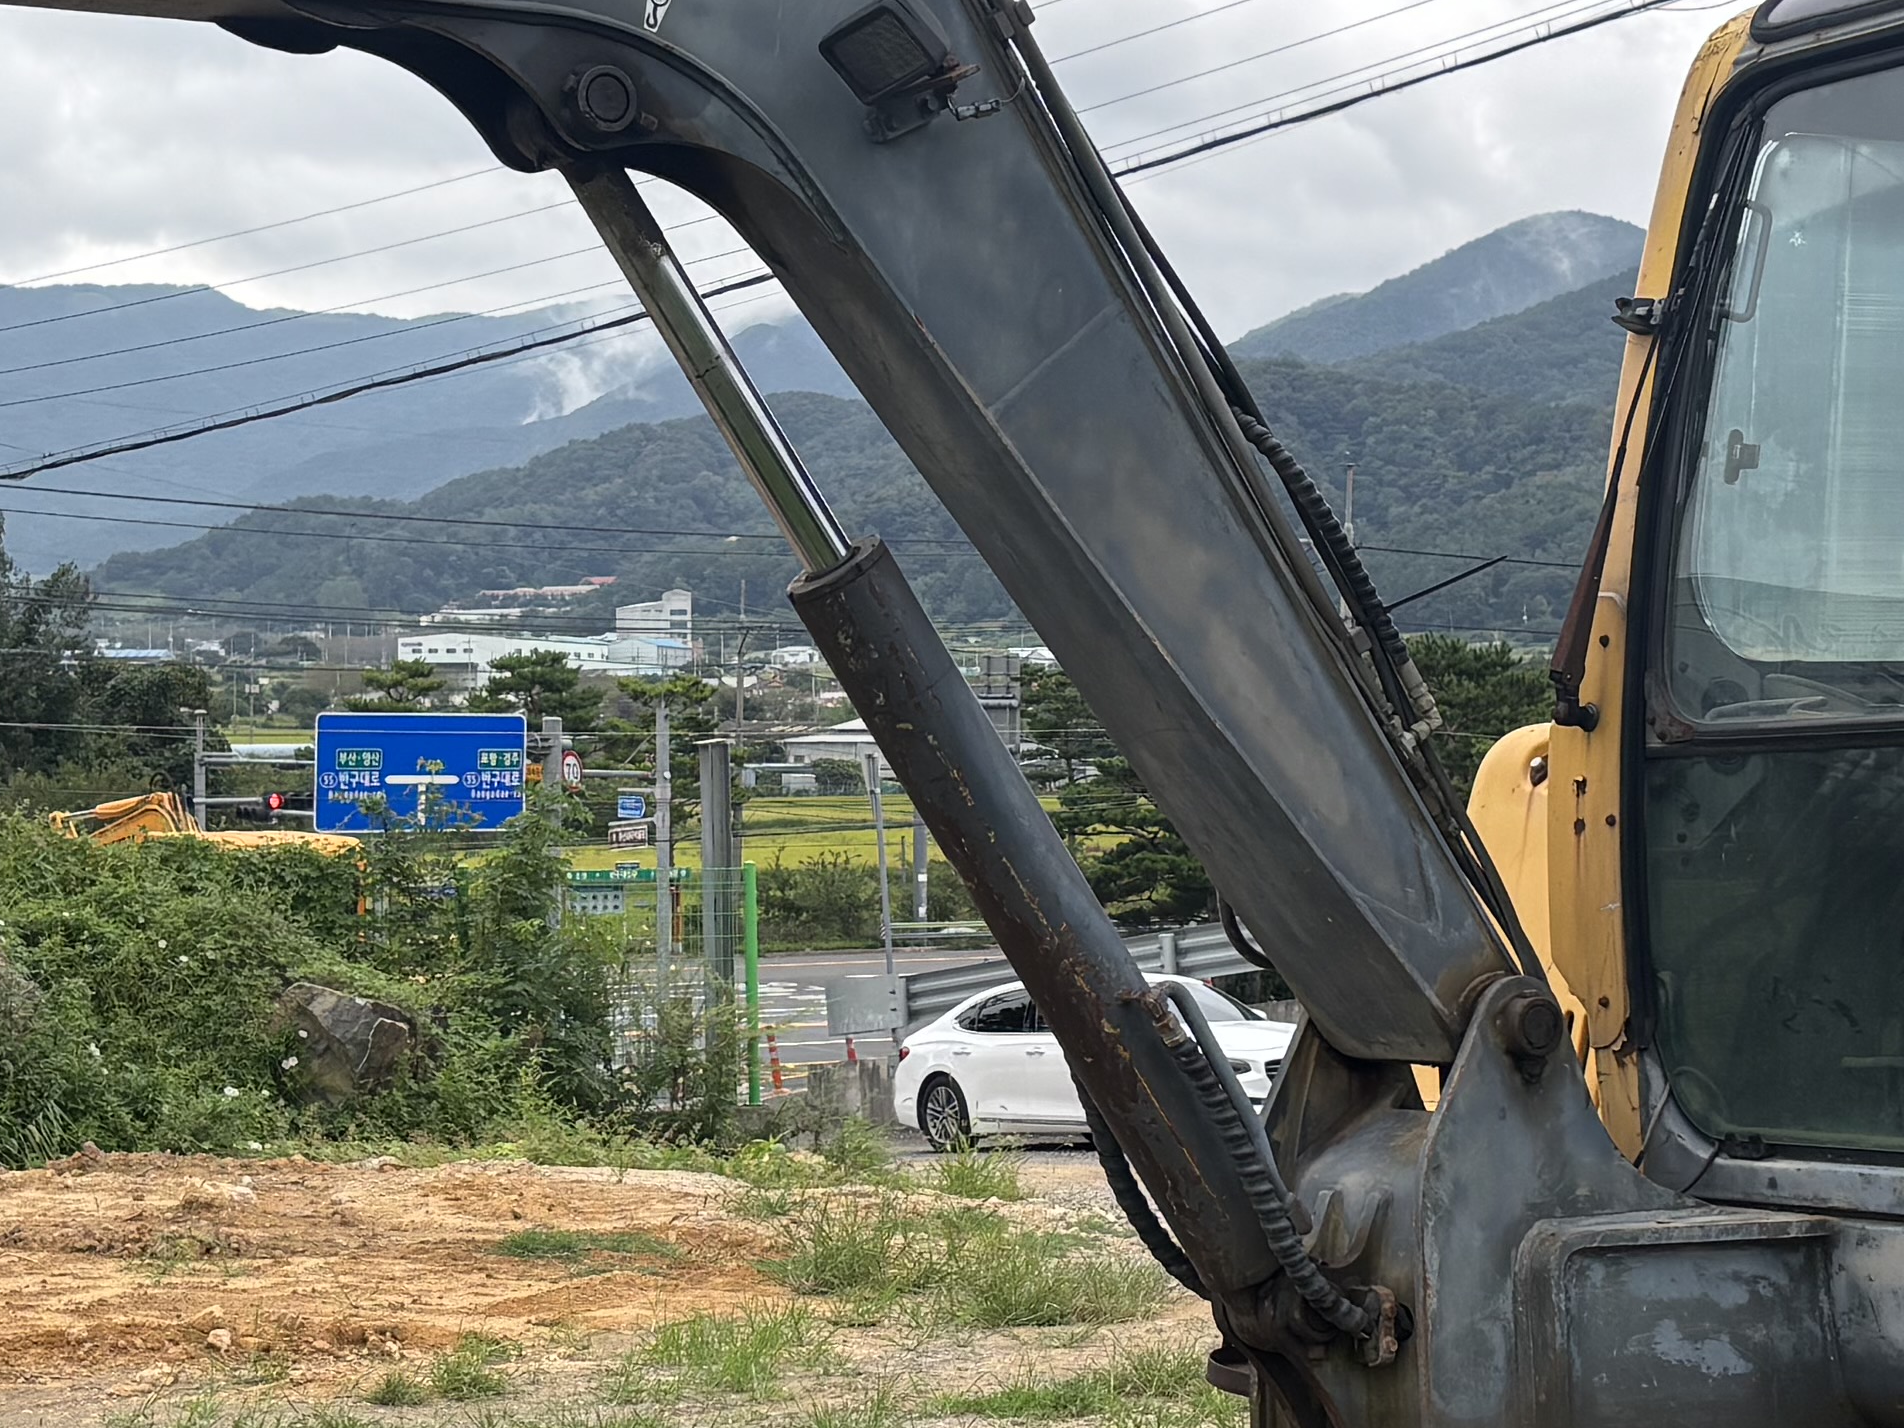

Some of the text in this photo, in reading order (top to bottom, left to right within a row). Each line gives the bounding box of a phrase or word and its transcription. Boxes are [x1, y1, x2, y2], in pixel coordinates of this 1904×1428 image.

[338, 771, 381, 790] 반구대로
[481, 771, 521, 789] 반구대로
[566, 763, 578, 780] 70
